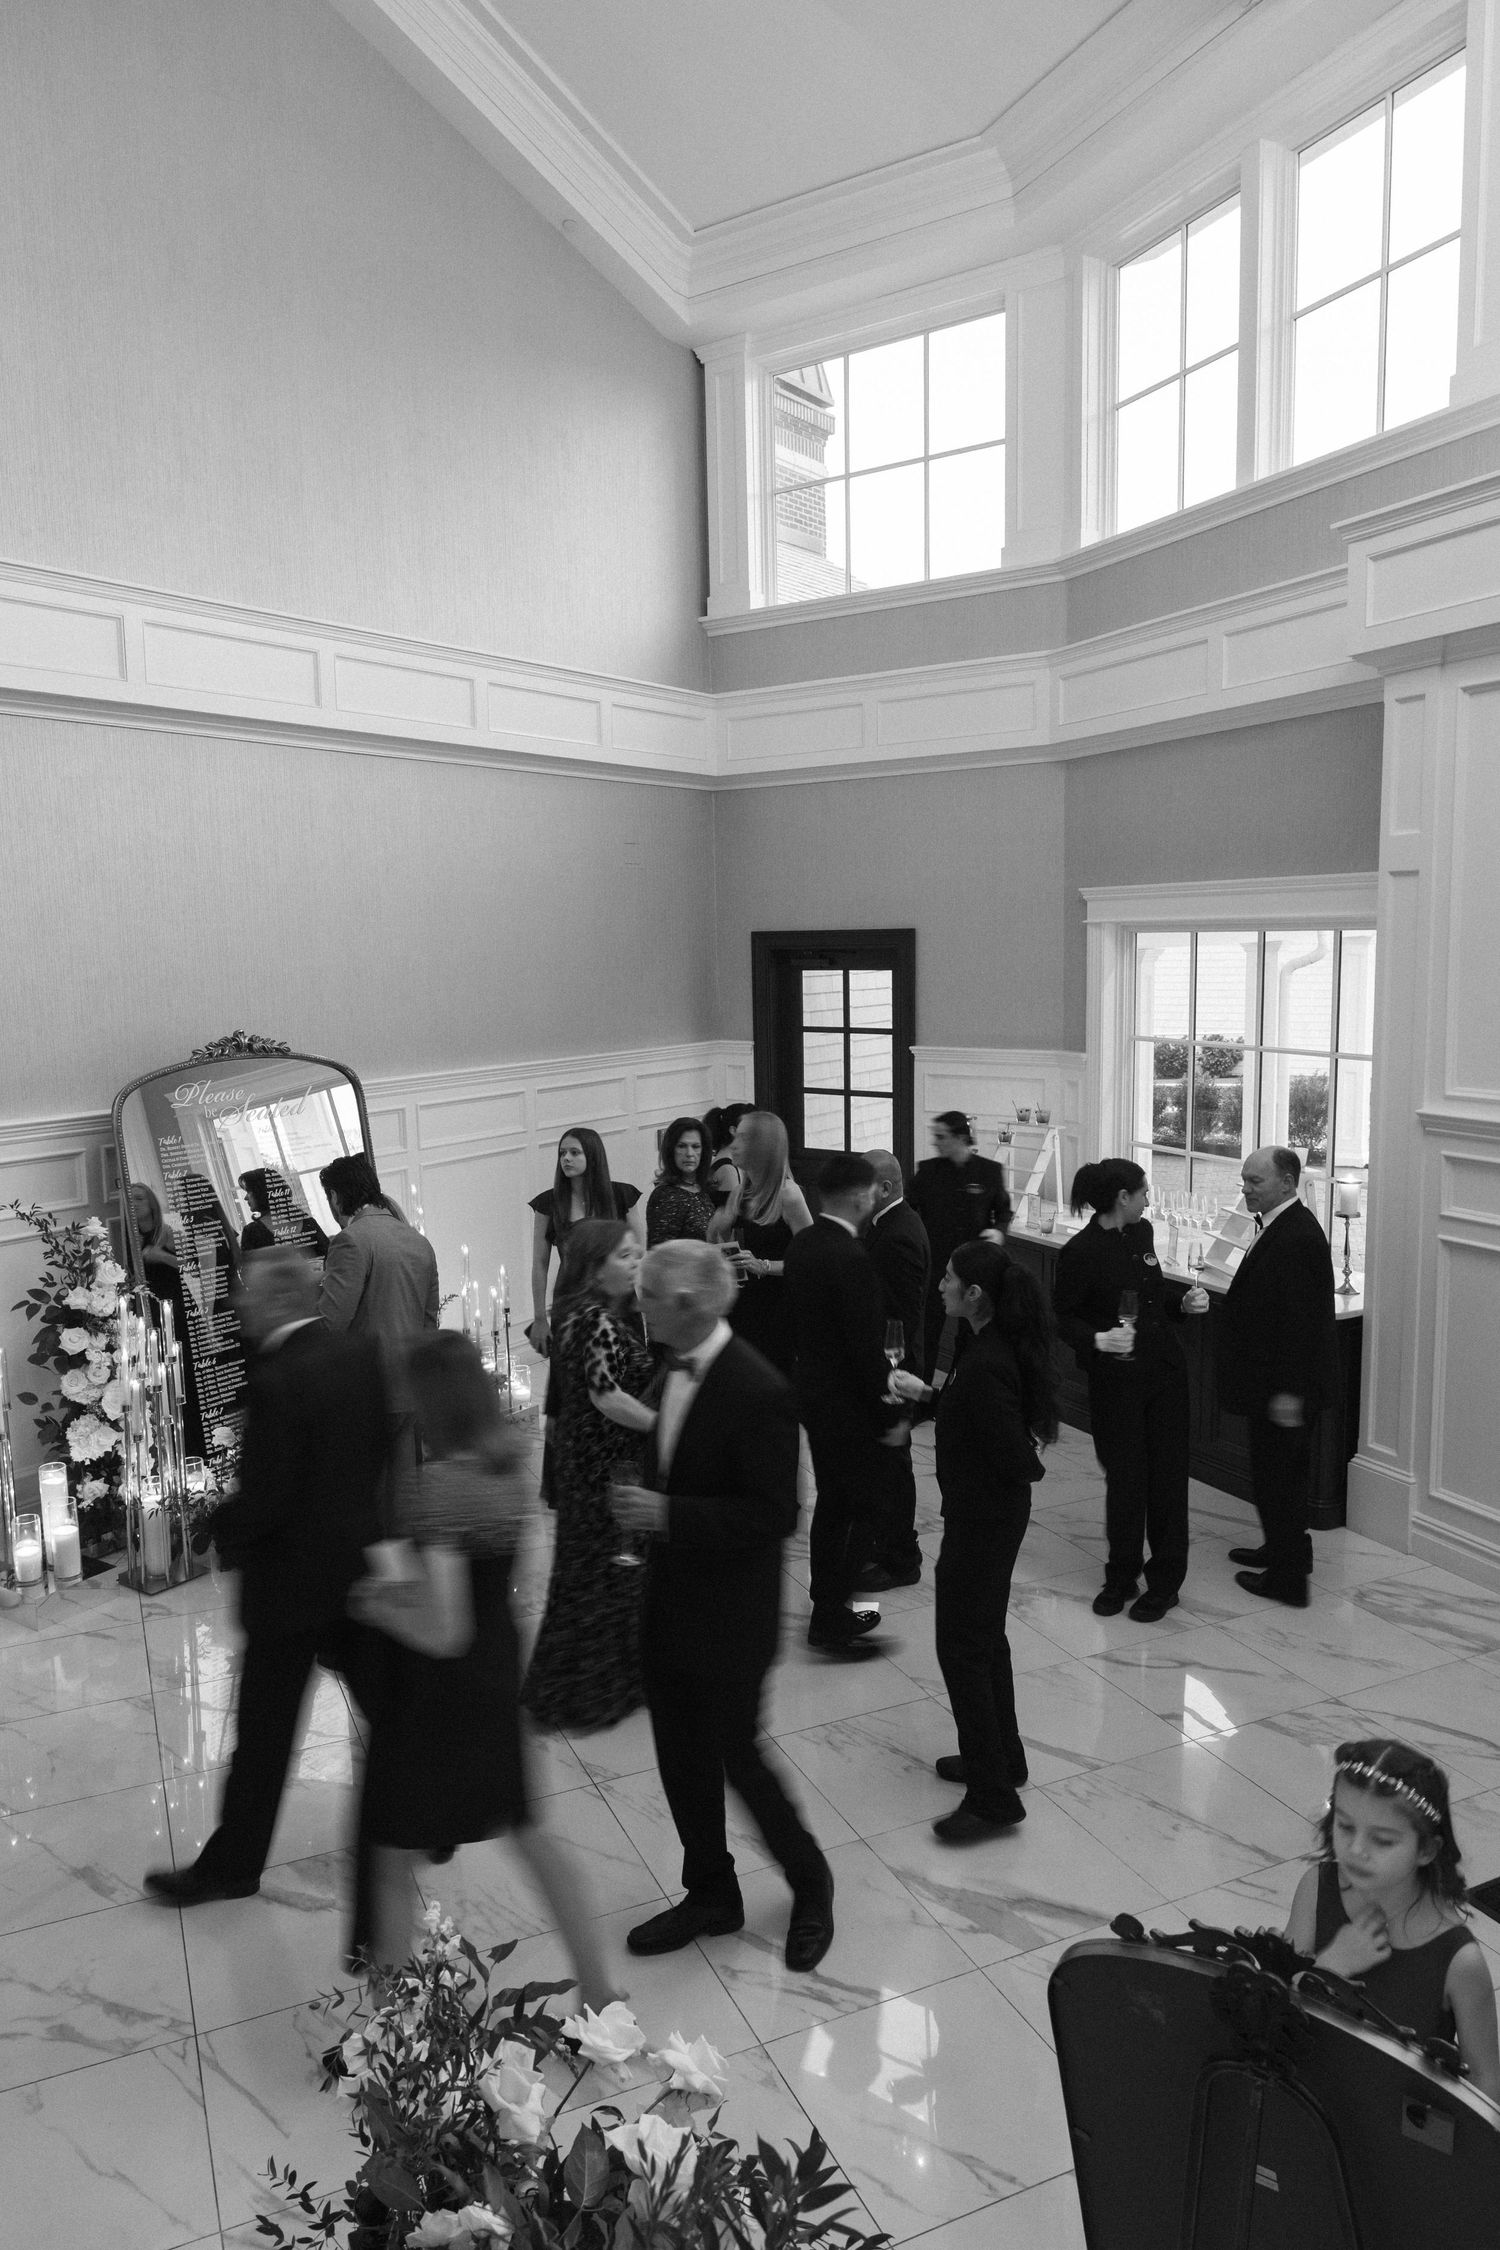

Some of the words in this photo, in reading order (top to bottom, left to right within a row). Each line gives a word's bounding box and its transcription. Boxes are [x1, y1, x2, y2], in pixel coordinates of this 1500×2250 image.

[171, 1080, 247, 1108] Please
[204, 1105, 218, 1119] be
[219, 1086, 313, 1128] Seated
[158, 1135, 178, 1146] Table
[163, 1169, 183, 1180] Table
[267, 1188, 284, 1199] Table
[273, 1226, 291, 1237] Table
[178, 1261, 197, 1273] Table
[192, 1357, 212, 1371] Table
[200, 1407, 219, 1421] Table
